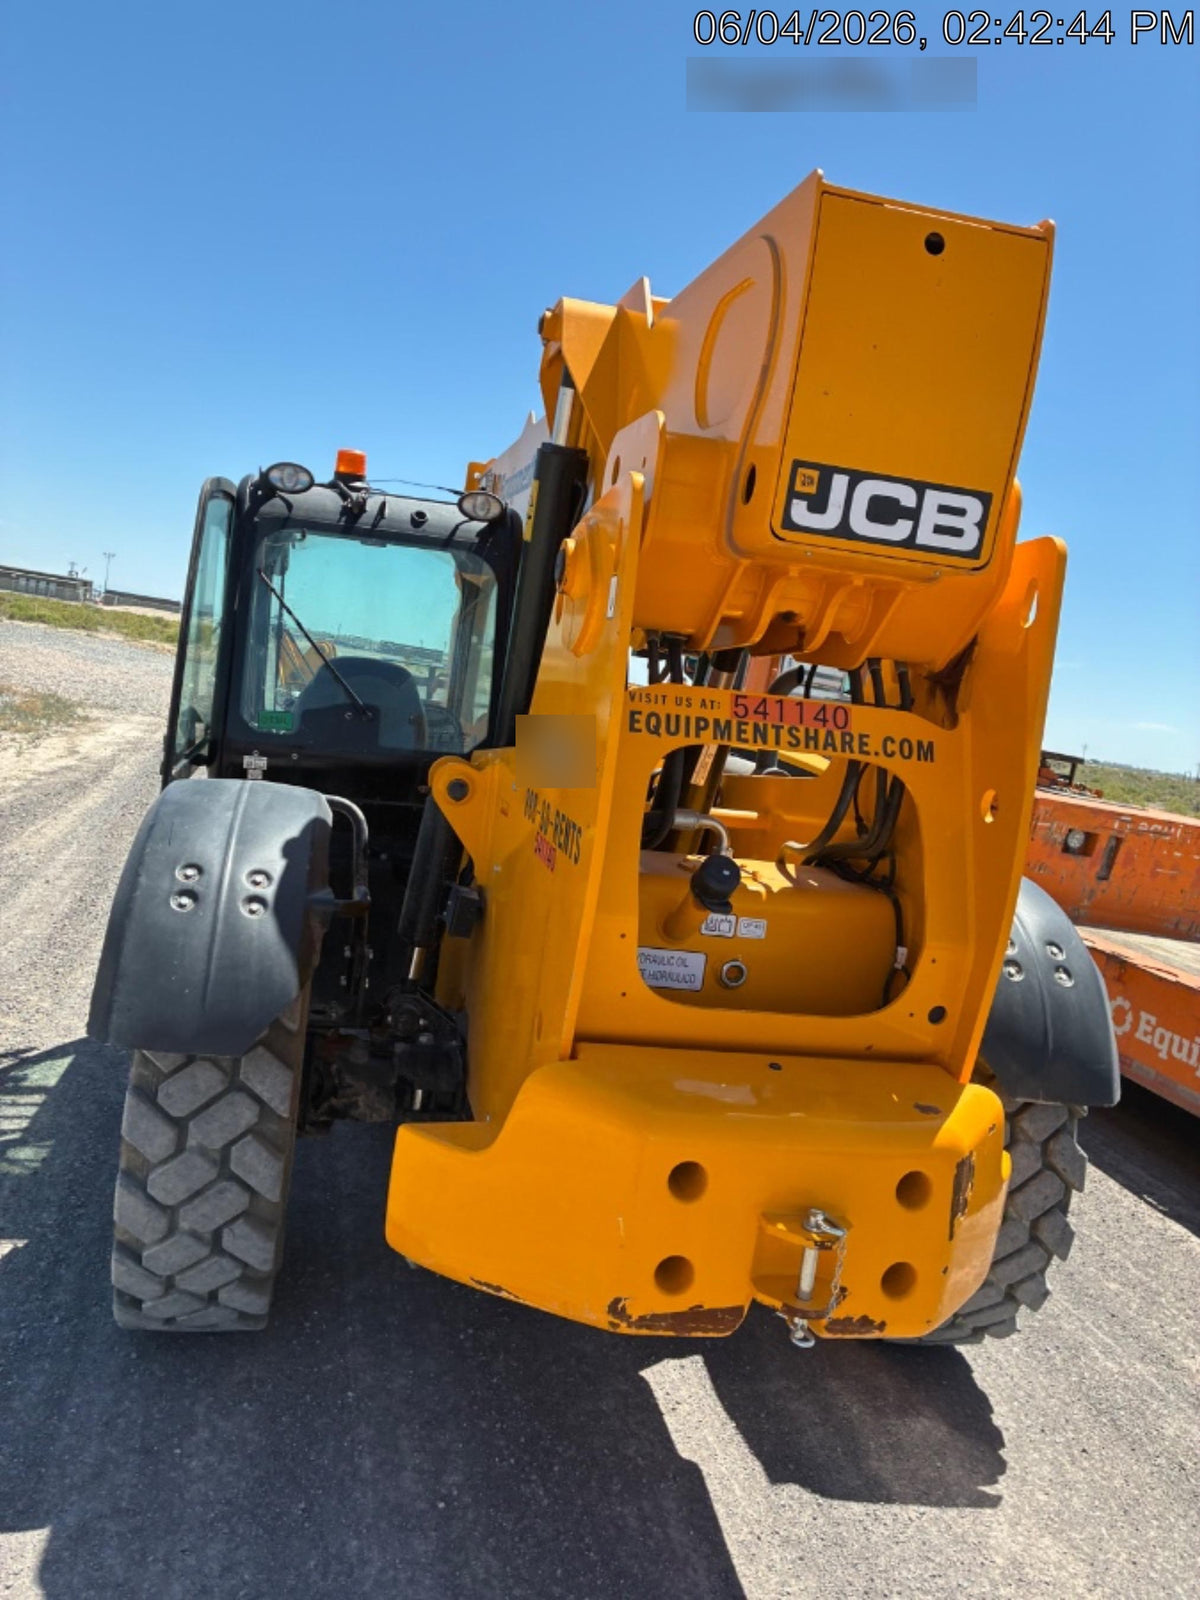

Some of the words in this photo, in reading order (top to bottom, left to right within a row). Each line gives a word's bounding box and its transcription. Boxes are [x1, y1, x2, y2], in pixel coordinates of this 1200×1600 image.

[790, 473, 984, 552] JCB
[628, 690, 668, 706] VISIT
[675, 695, 693, 708] US
[700, 698, 722, 711] AT:
[732, 693, 850, 730] 541140
[628, 709, 936, 763] EQUIPMENTSHARE.COM
